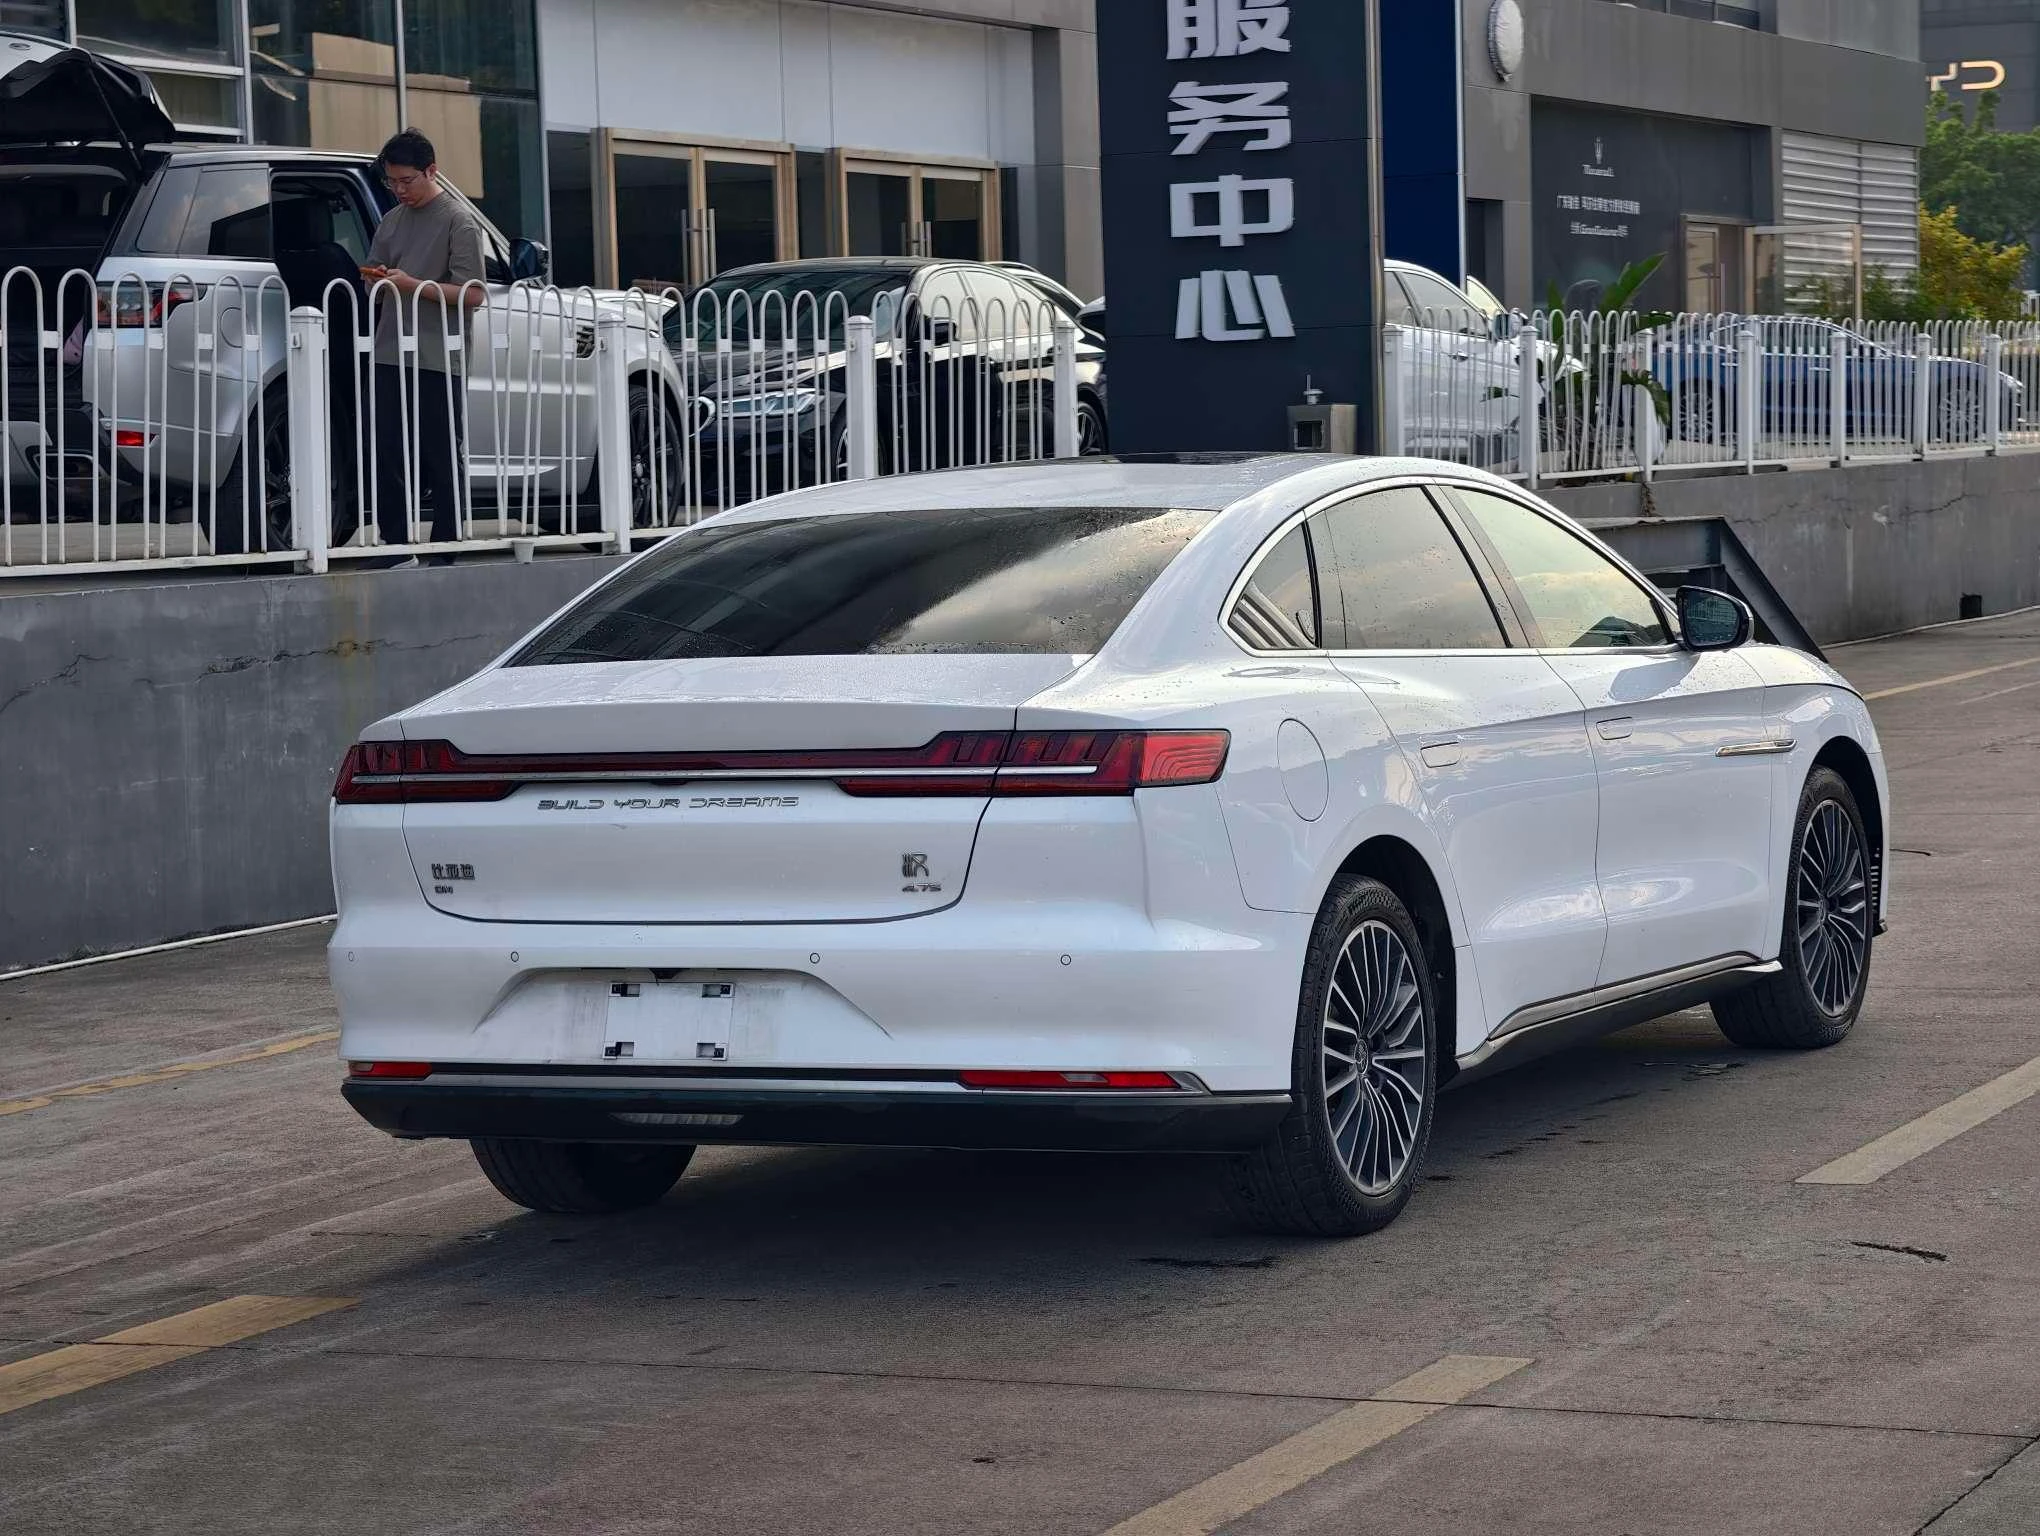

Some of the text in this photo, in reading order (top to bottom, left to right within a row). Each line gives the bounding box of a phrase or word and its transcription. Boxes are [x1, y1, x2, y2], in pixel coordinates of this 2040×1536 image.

[1925, 60, 2006, 91] YD
[1166, 0, 1296, 342] 服务中心
[537, 796, 800, 810] BUILD YOUR DREAMS
